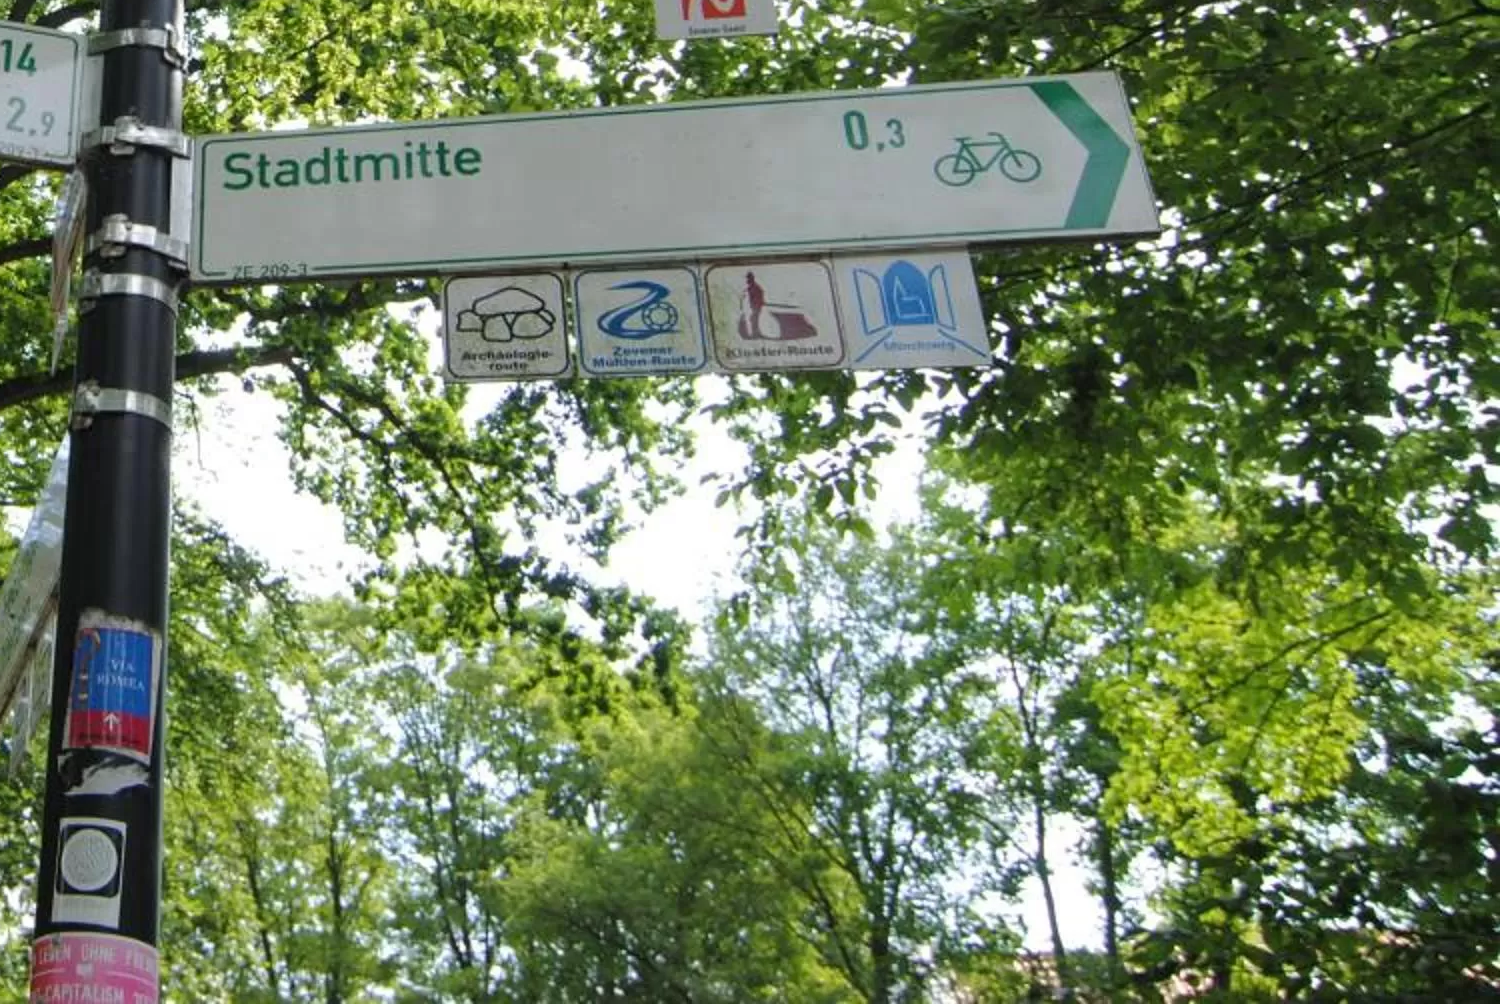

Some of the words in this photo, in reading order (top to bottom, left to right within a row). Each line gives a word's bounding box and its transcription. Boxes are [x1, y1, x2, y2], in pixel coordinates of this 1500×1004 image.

[0, 39, 37, 76] 14
[223, 141, 482, 190] Stadtmitte
[233, 265, 252, 280] ZE
[726, 344, 835, 360] Kloster-Route
